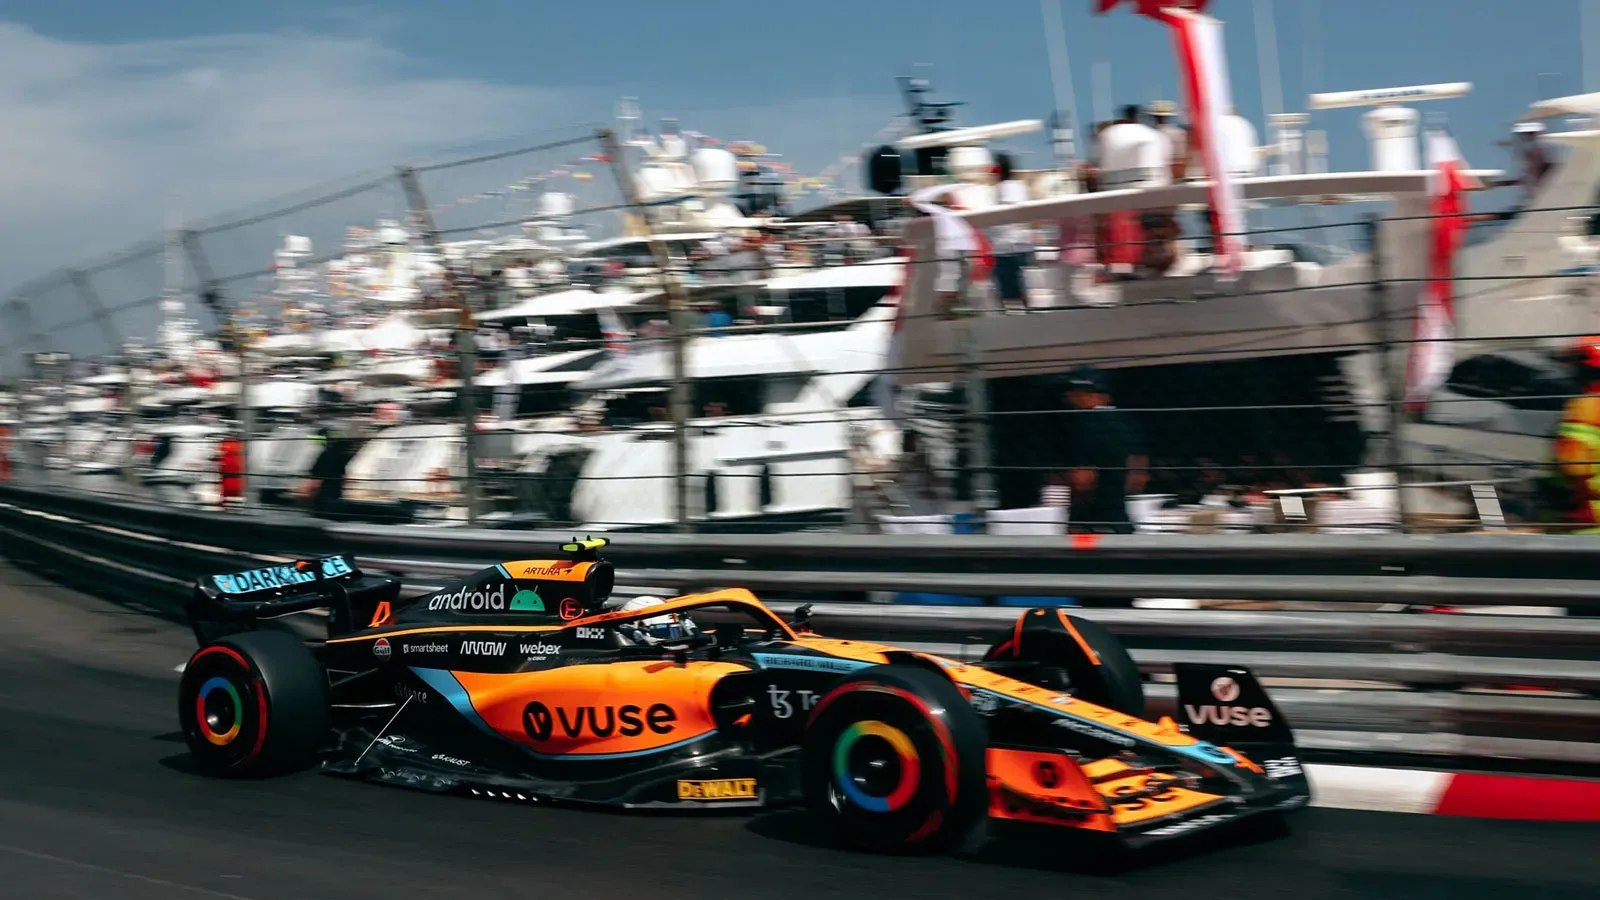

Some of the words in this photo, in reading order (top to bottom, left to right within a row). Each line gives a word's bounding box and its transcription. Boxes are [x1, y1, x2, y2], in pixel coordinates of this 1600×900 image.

[232, 556, 346, 591] DARKTCE
[523, 567, 560, 576] ARTURA
[428, 584, 504, 611] android
[410, 642, 448, 653] smartsheet
[460, 640, 507, 656] ARROW
[519, 641, 562, 655] webex
[557, 702, 677, 738] vuse
[1185, 704, 1272, 728] vuse
